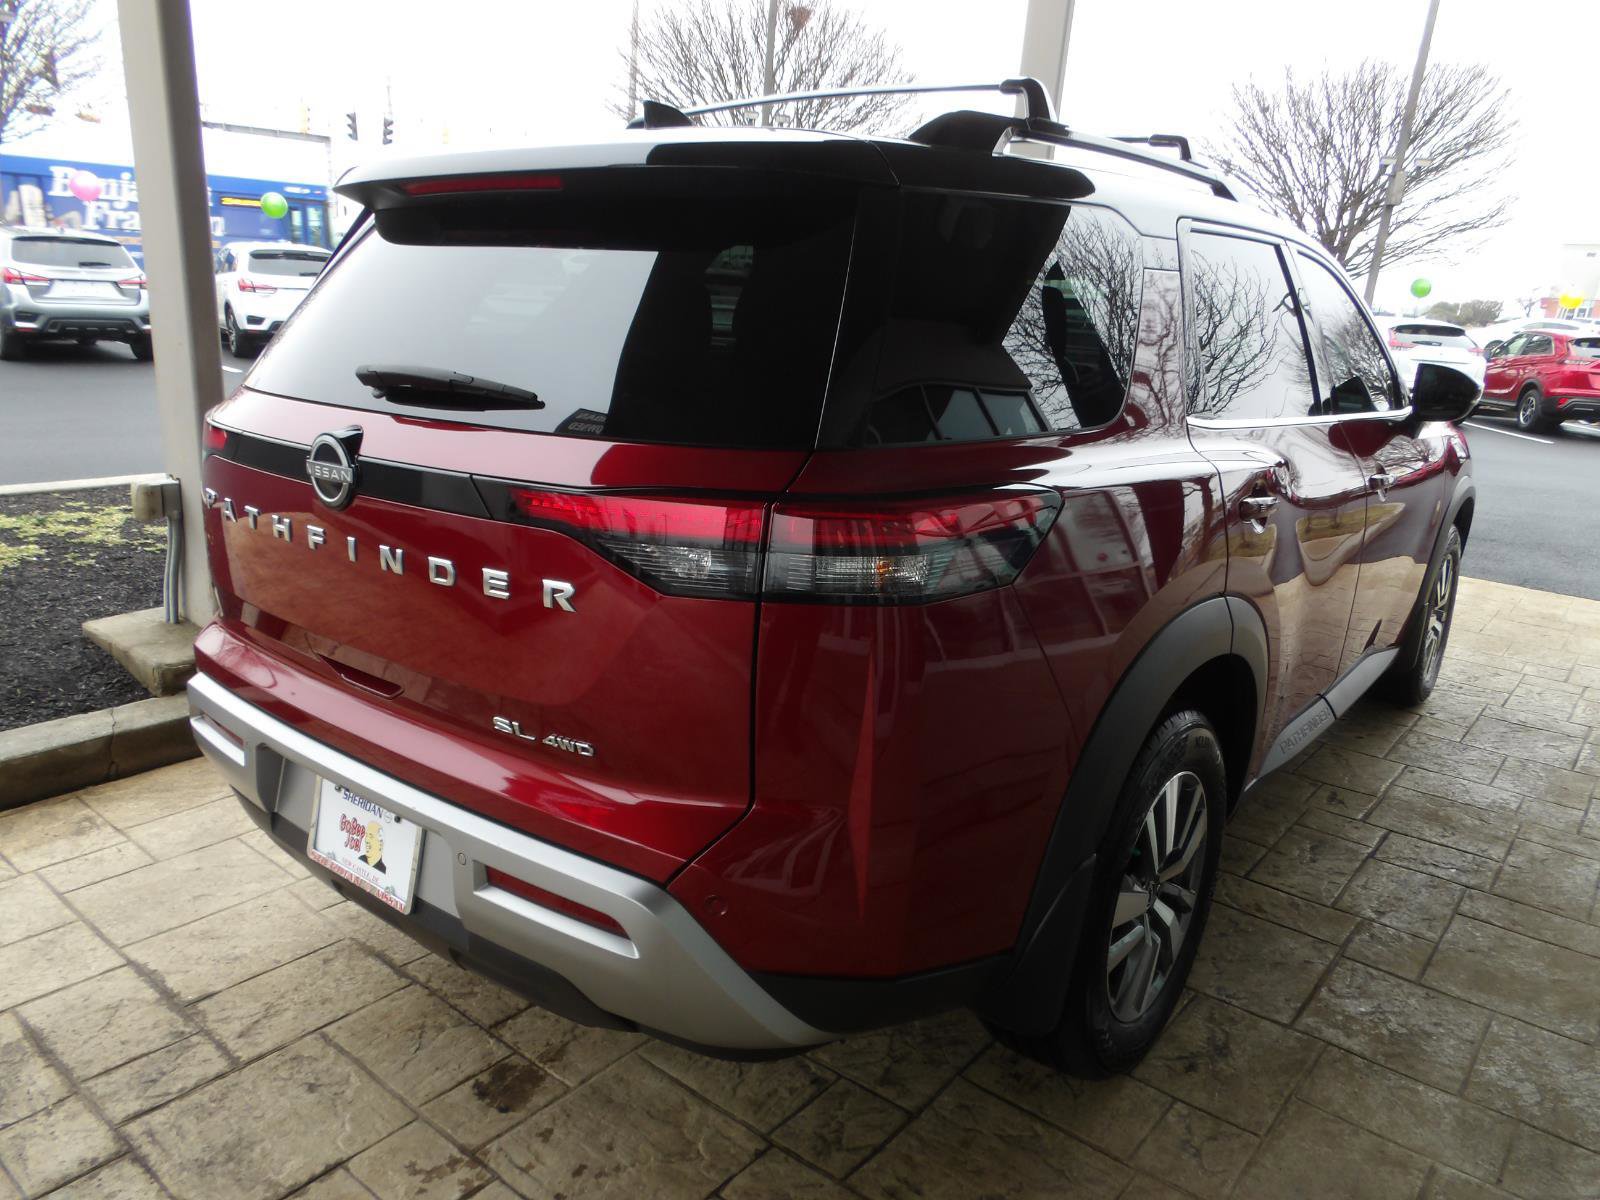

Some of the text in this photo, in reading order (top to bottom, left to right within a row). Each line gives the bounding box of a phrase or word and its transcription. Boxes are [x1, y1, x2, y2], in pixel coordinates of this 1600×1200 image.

[204, 487, 577, 613] PATHFINDER
[492, 716, 595, 757] SL 4WD
[343, 789, 384, 818] SHERIDAN
